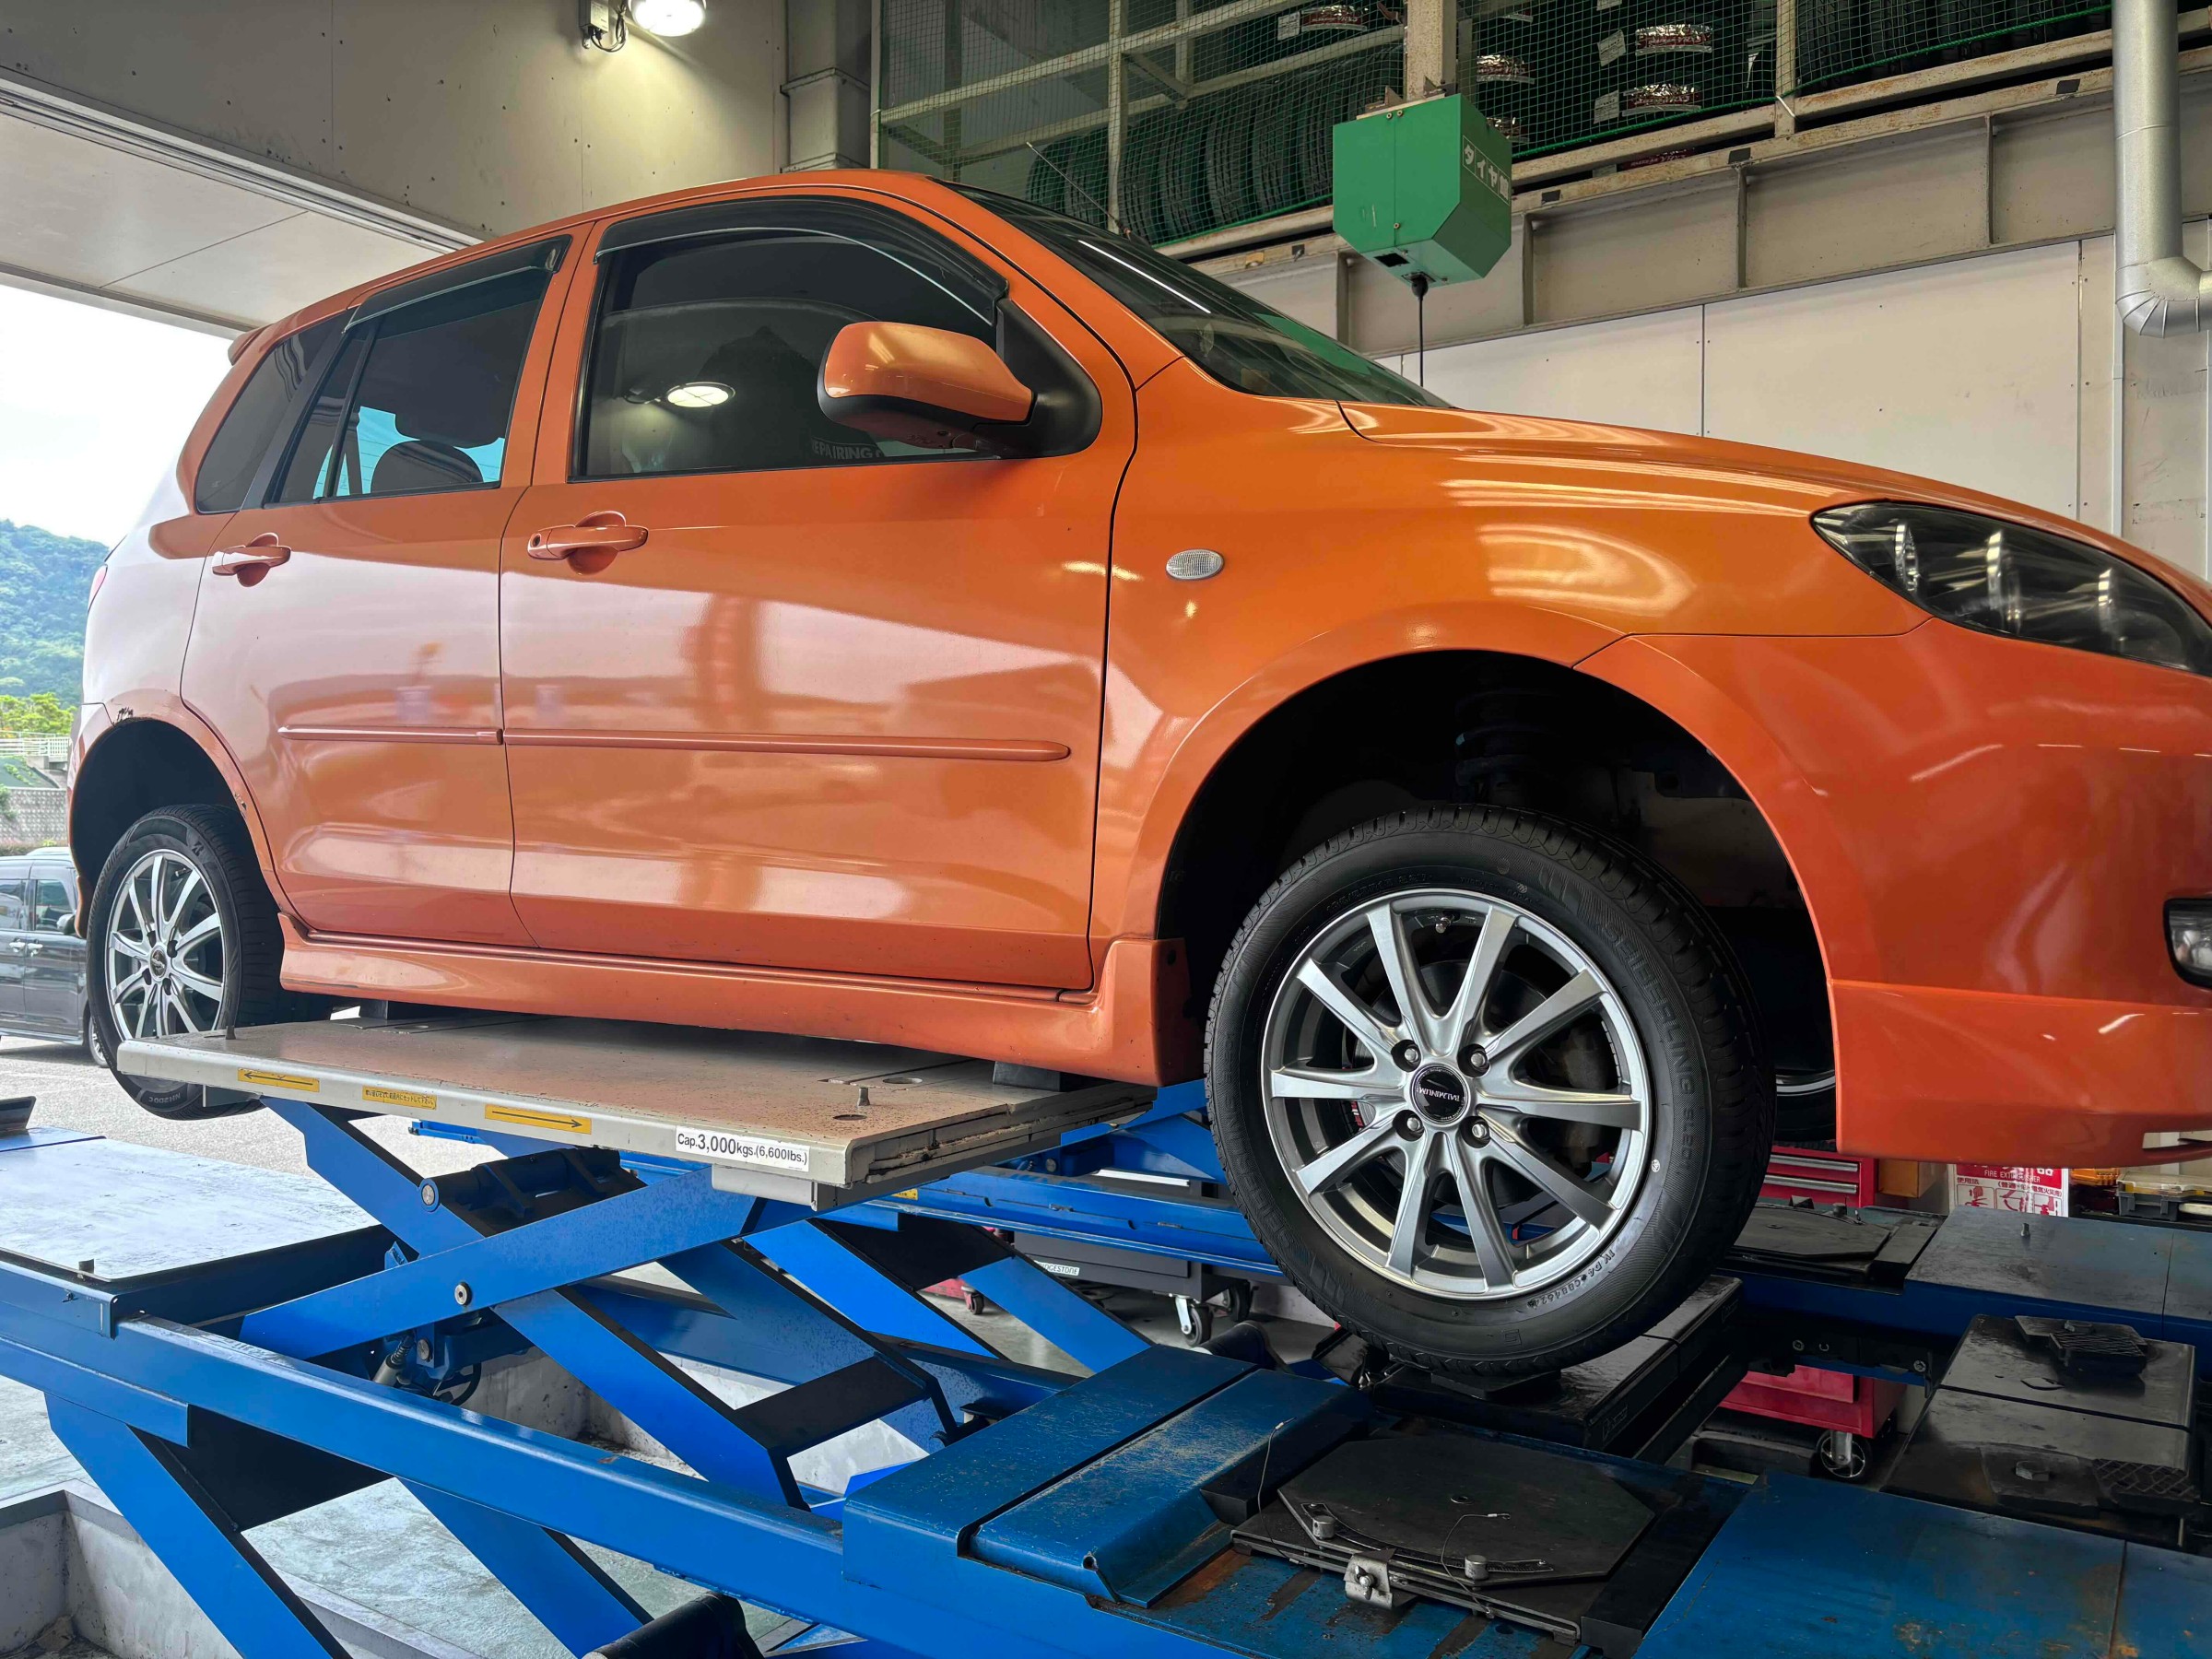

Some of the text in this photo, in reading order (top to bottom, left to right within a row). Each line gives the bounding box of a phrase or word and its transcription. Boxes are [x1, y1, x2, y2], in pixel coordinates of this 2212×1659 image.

[1601, 922, 1696, 1096] SEIBERLING
[1984, 1170, 1997, 1179] FIRE
[1999, 1171, 2041, 1183] EXTINGUSHER
[1040, 1263, 1078, 1275] IDGESTONE
